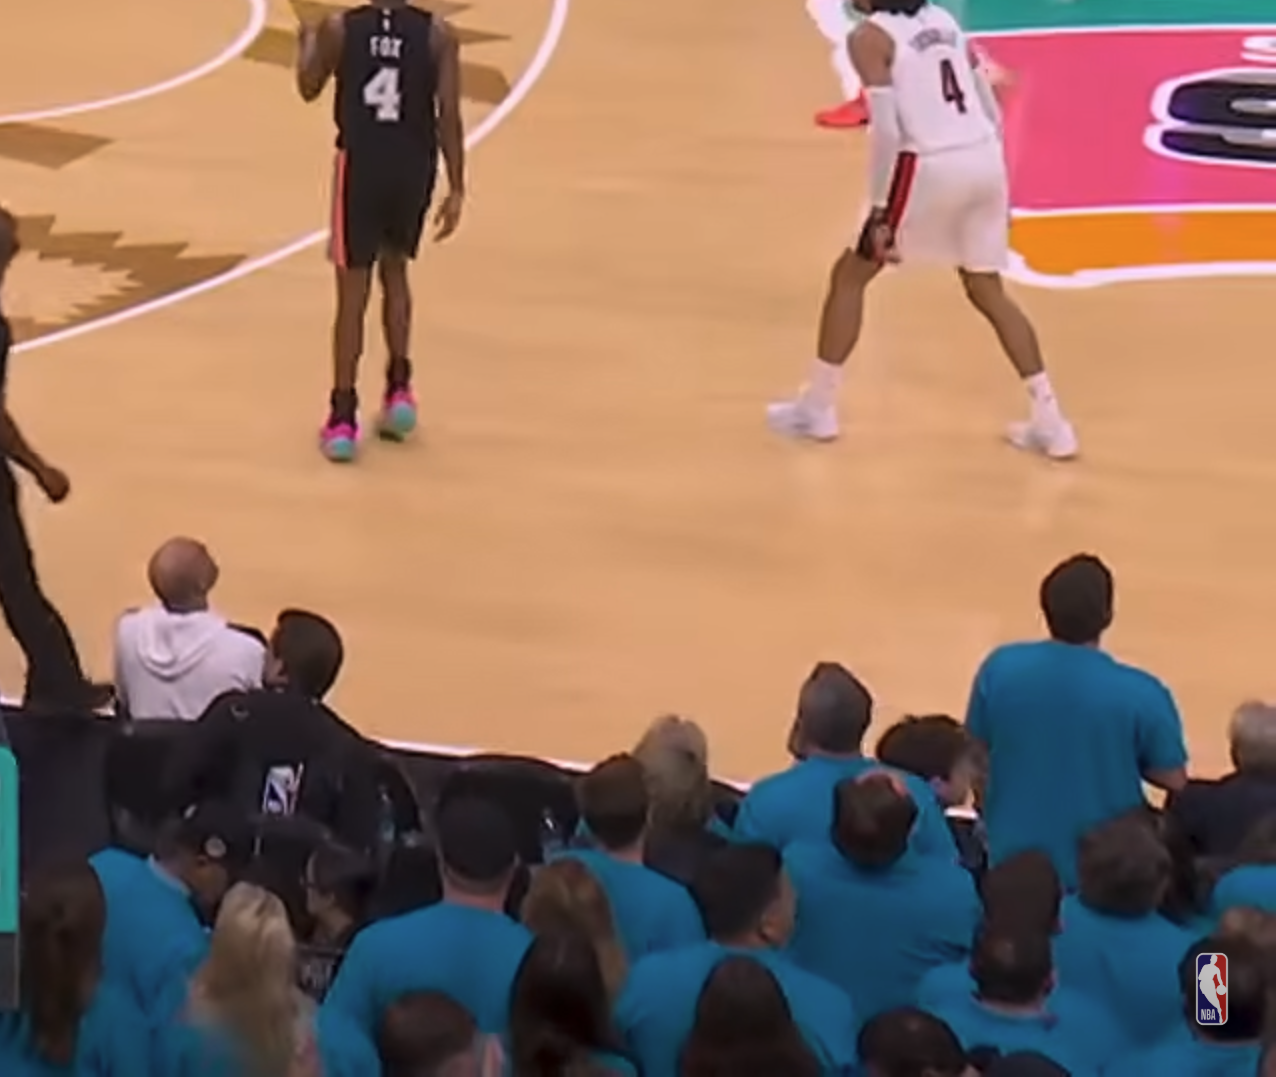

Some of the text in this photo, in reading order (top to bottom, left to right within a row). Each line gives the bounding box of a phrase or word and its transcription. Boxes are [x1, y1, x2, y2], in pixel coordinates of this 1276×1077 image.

[369, 36, 403, 59] FOX
[363, 67, 401, 122] 4
[939, 58, 967, 115] 4
